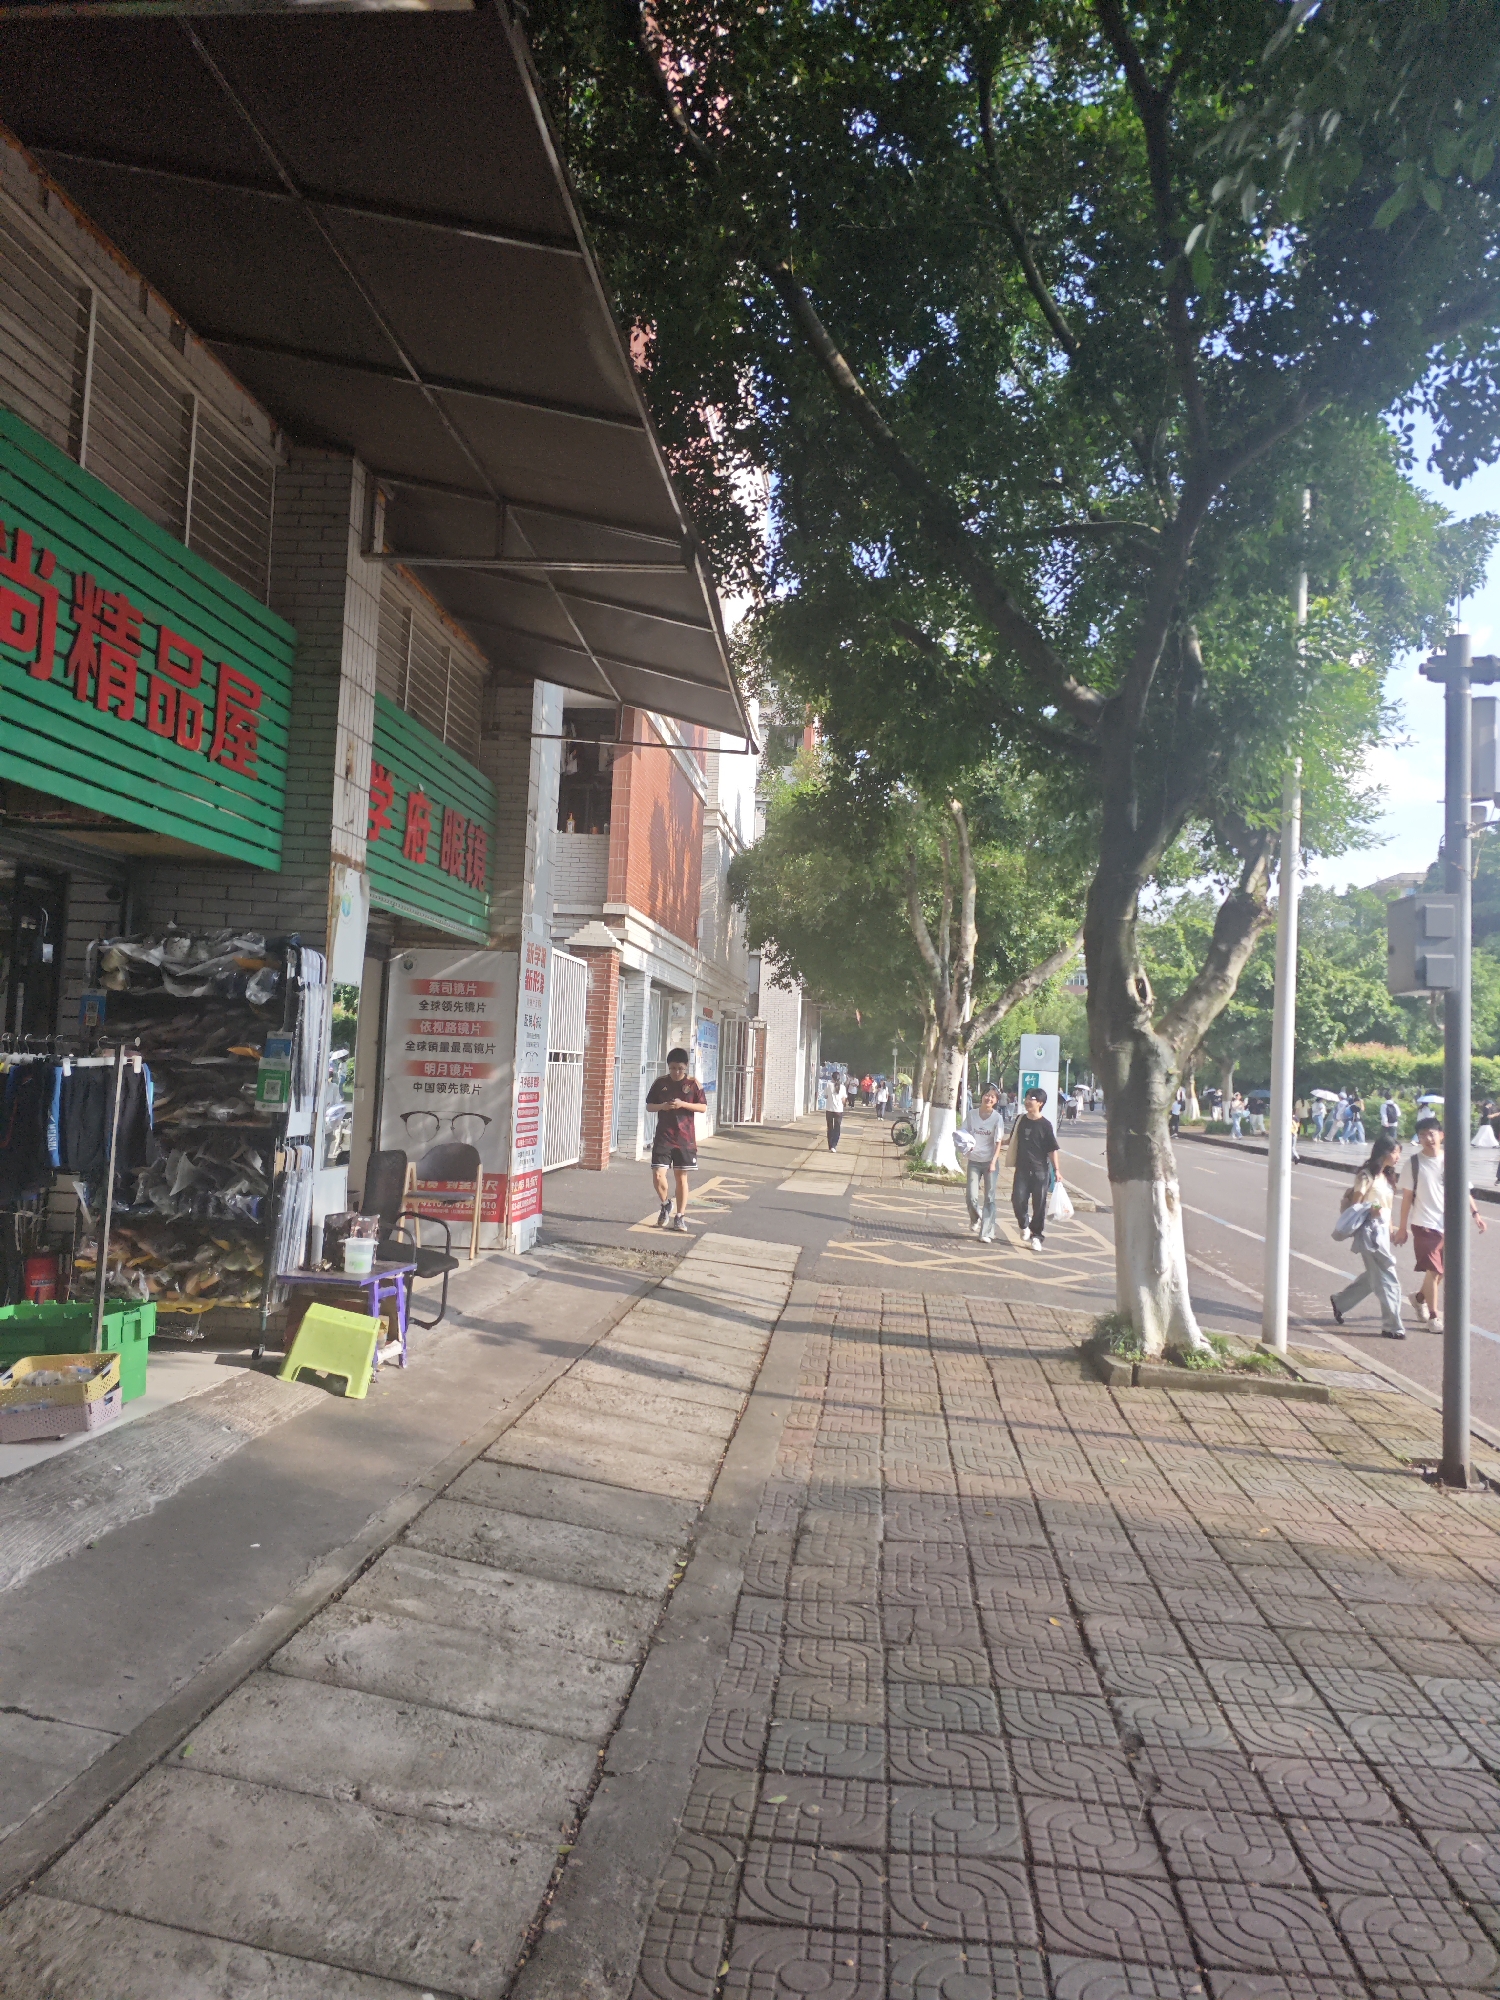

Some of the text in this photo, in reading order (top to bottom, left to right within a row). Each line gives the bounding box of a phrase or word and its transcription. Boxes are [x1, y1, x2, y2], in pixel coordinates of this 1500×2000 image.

[428, 981, 478, 996] 蔡司镜片
[418, 1000, 487, 1013] 全球领先镜片
[420, 1020, 482, 1036] 依视路镜片
[404, 1040, 497, 1055] 全球销量最高镜片
[424, 1062, 474, 1077] 明月镜片
[413, 1082, 483, 1096] 中国领先镜片
